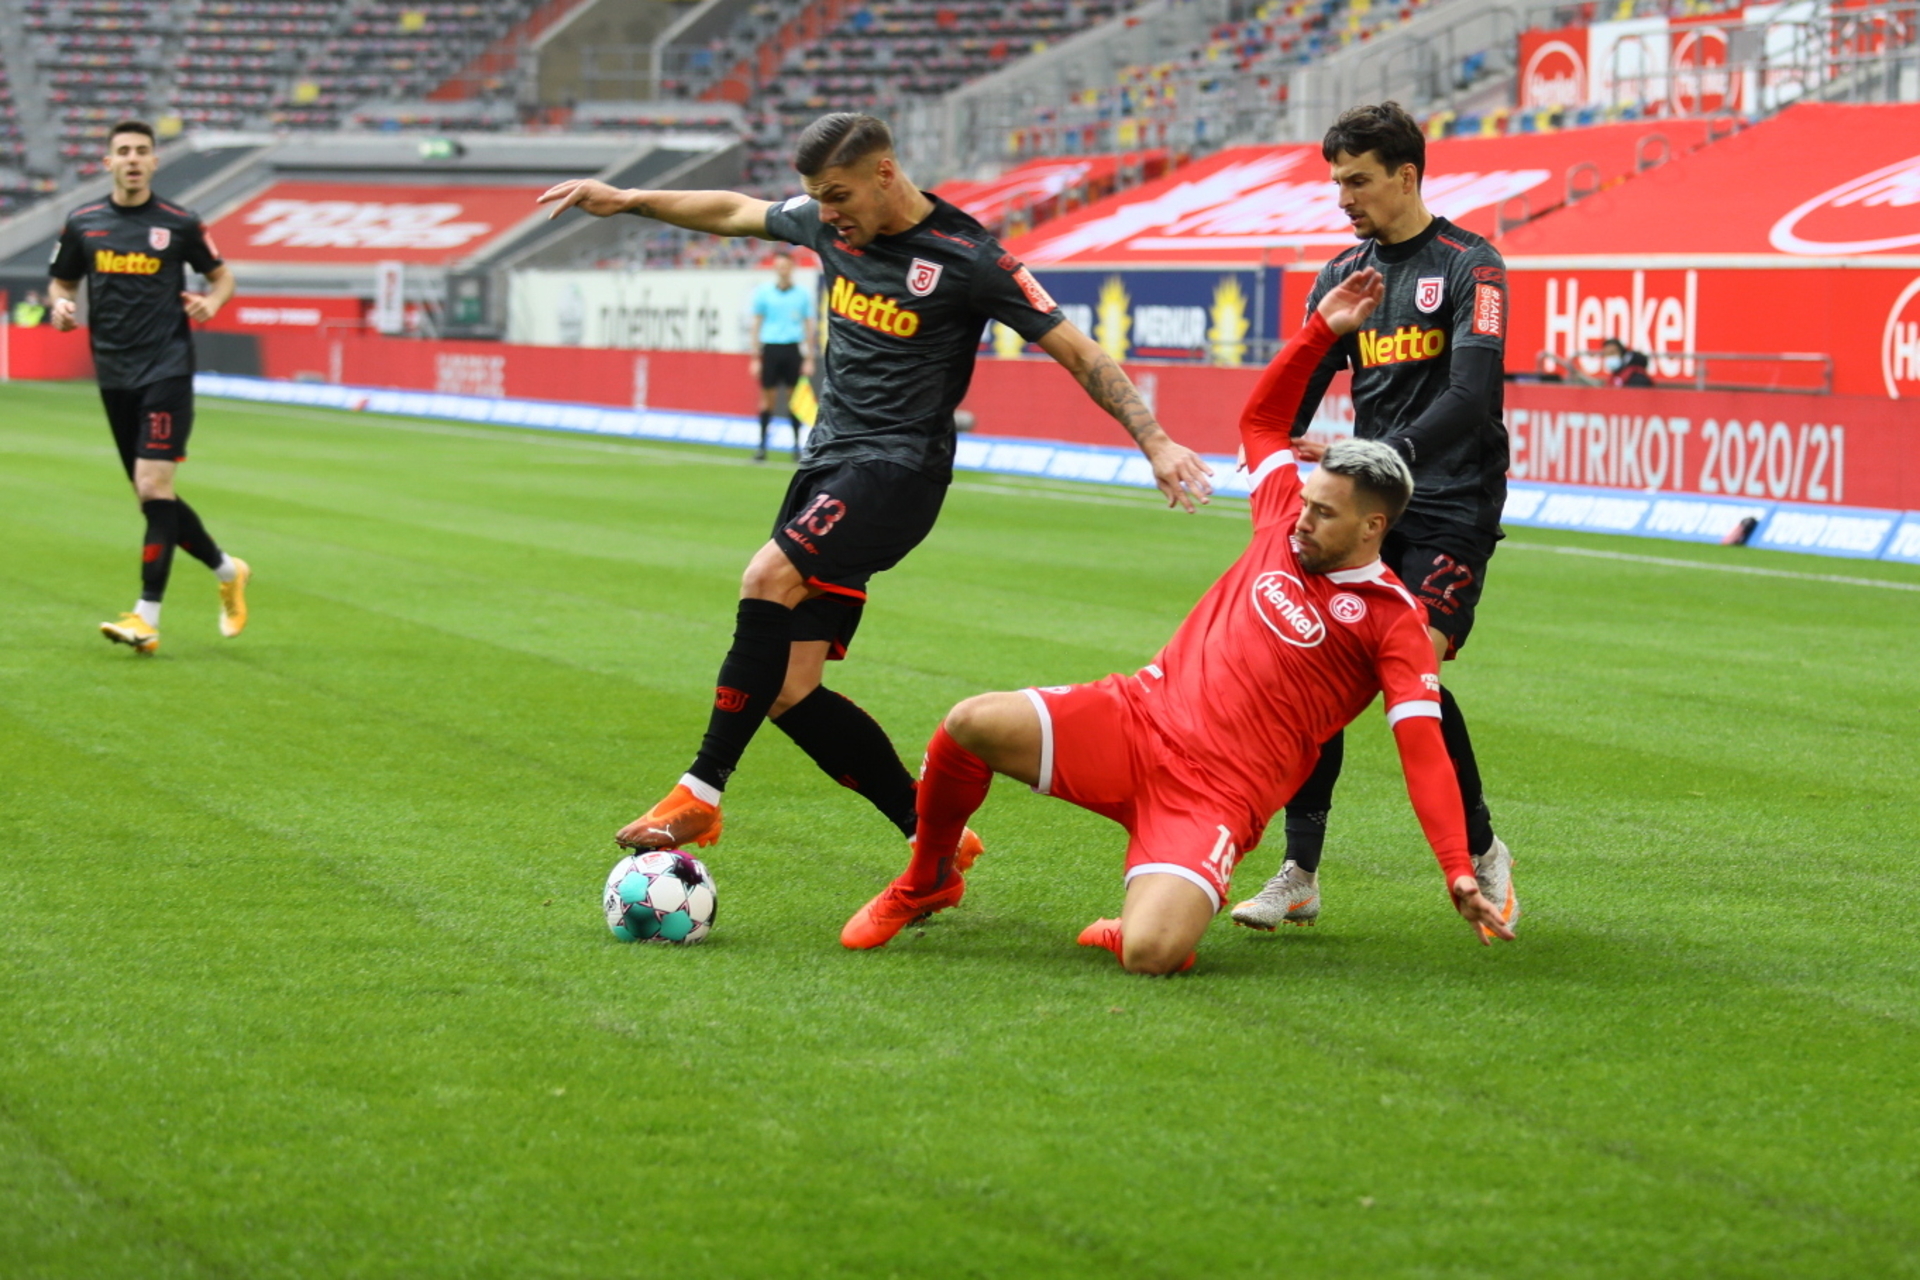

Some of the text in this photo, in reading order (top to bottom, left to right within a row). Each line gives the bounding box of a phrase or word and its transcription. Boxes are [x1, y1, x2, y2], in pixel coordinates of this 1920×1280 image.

[95, 251, 162, 275] Netto
[831, 277, 920, 337] Netto
[1544, 270, 1698, 378] Henkel
[1358, 326, 1445, 367] Netto
[148, 412, 172, 439] 10
[1701, 418, 1844, 503] 2020/21
[796, 494, 846, 536] 13
[1764, 512, 1891, 552] TOYO TIRES
[1421, 554, 1474, 608] 22
[1257, 577, 1321, 640] Henkel
[1209, 824, 1236, 884] 18
